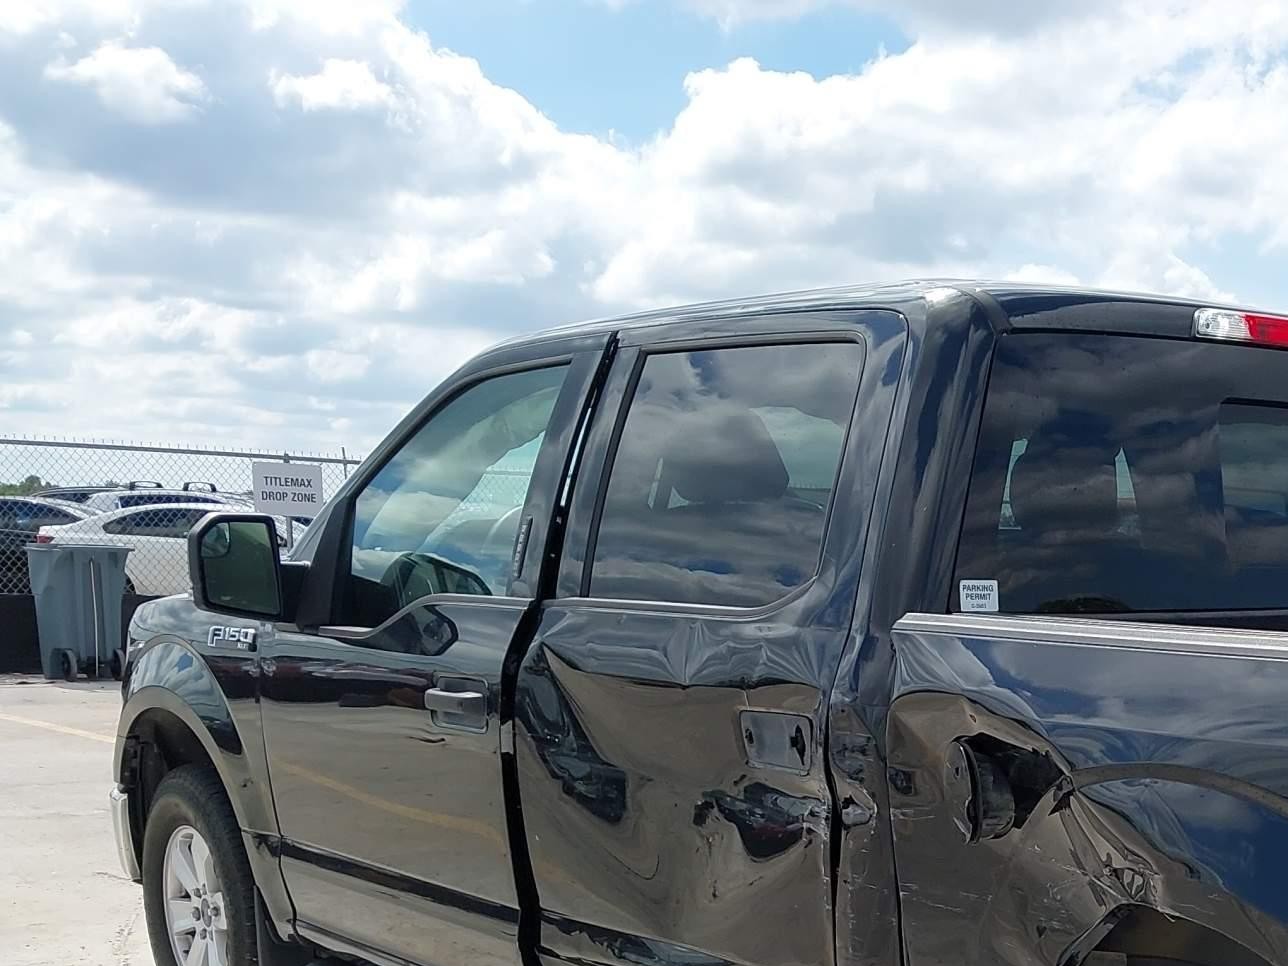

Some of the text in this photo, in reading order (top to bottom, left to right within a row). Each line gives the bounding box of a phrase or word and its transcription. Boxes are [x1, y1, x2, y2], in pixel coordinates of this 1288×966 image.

[263, 476, 313, 488] TITLEMAX
[261, 490, 317, 503] DROP ZONE
[962, 584, 994, 592] PARKING
[965, 592, 991, 600] PERMIT
